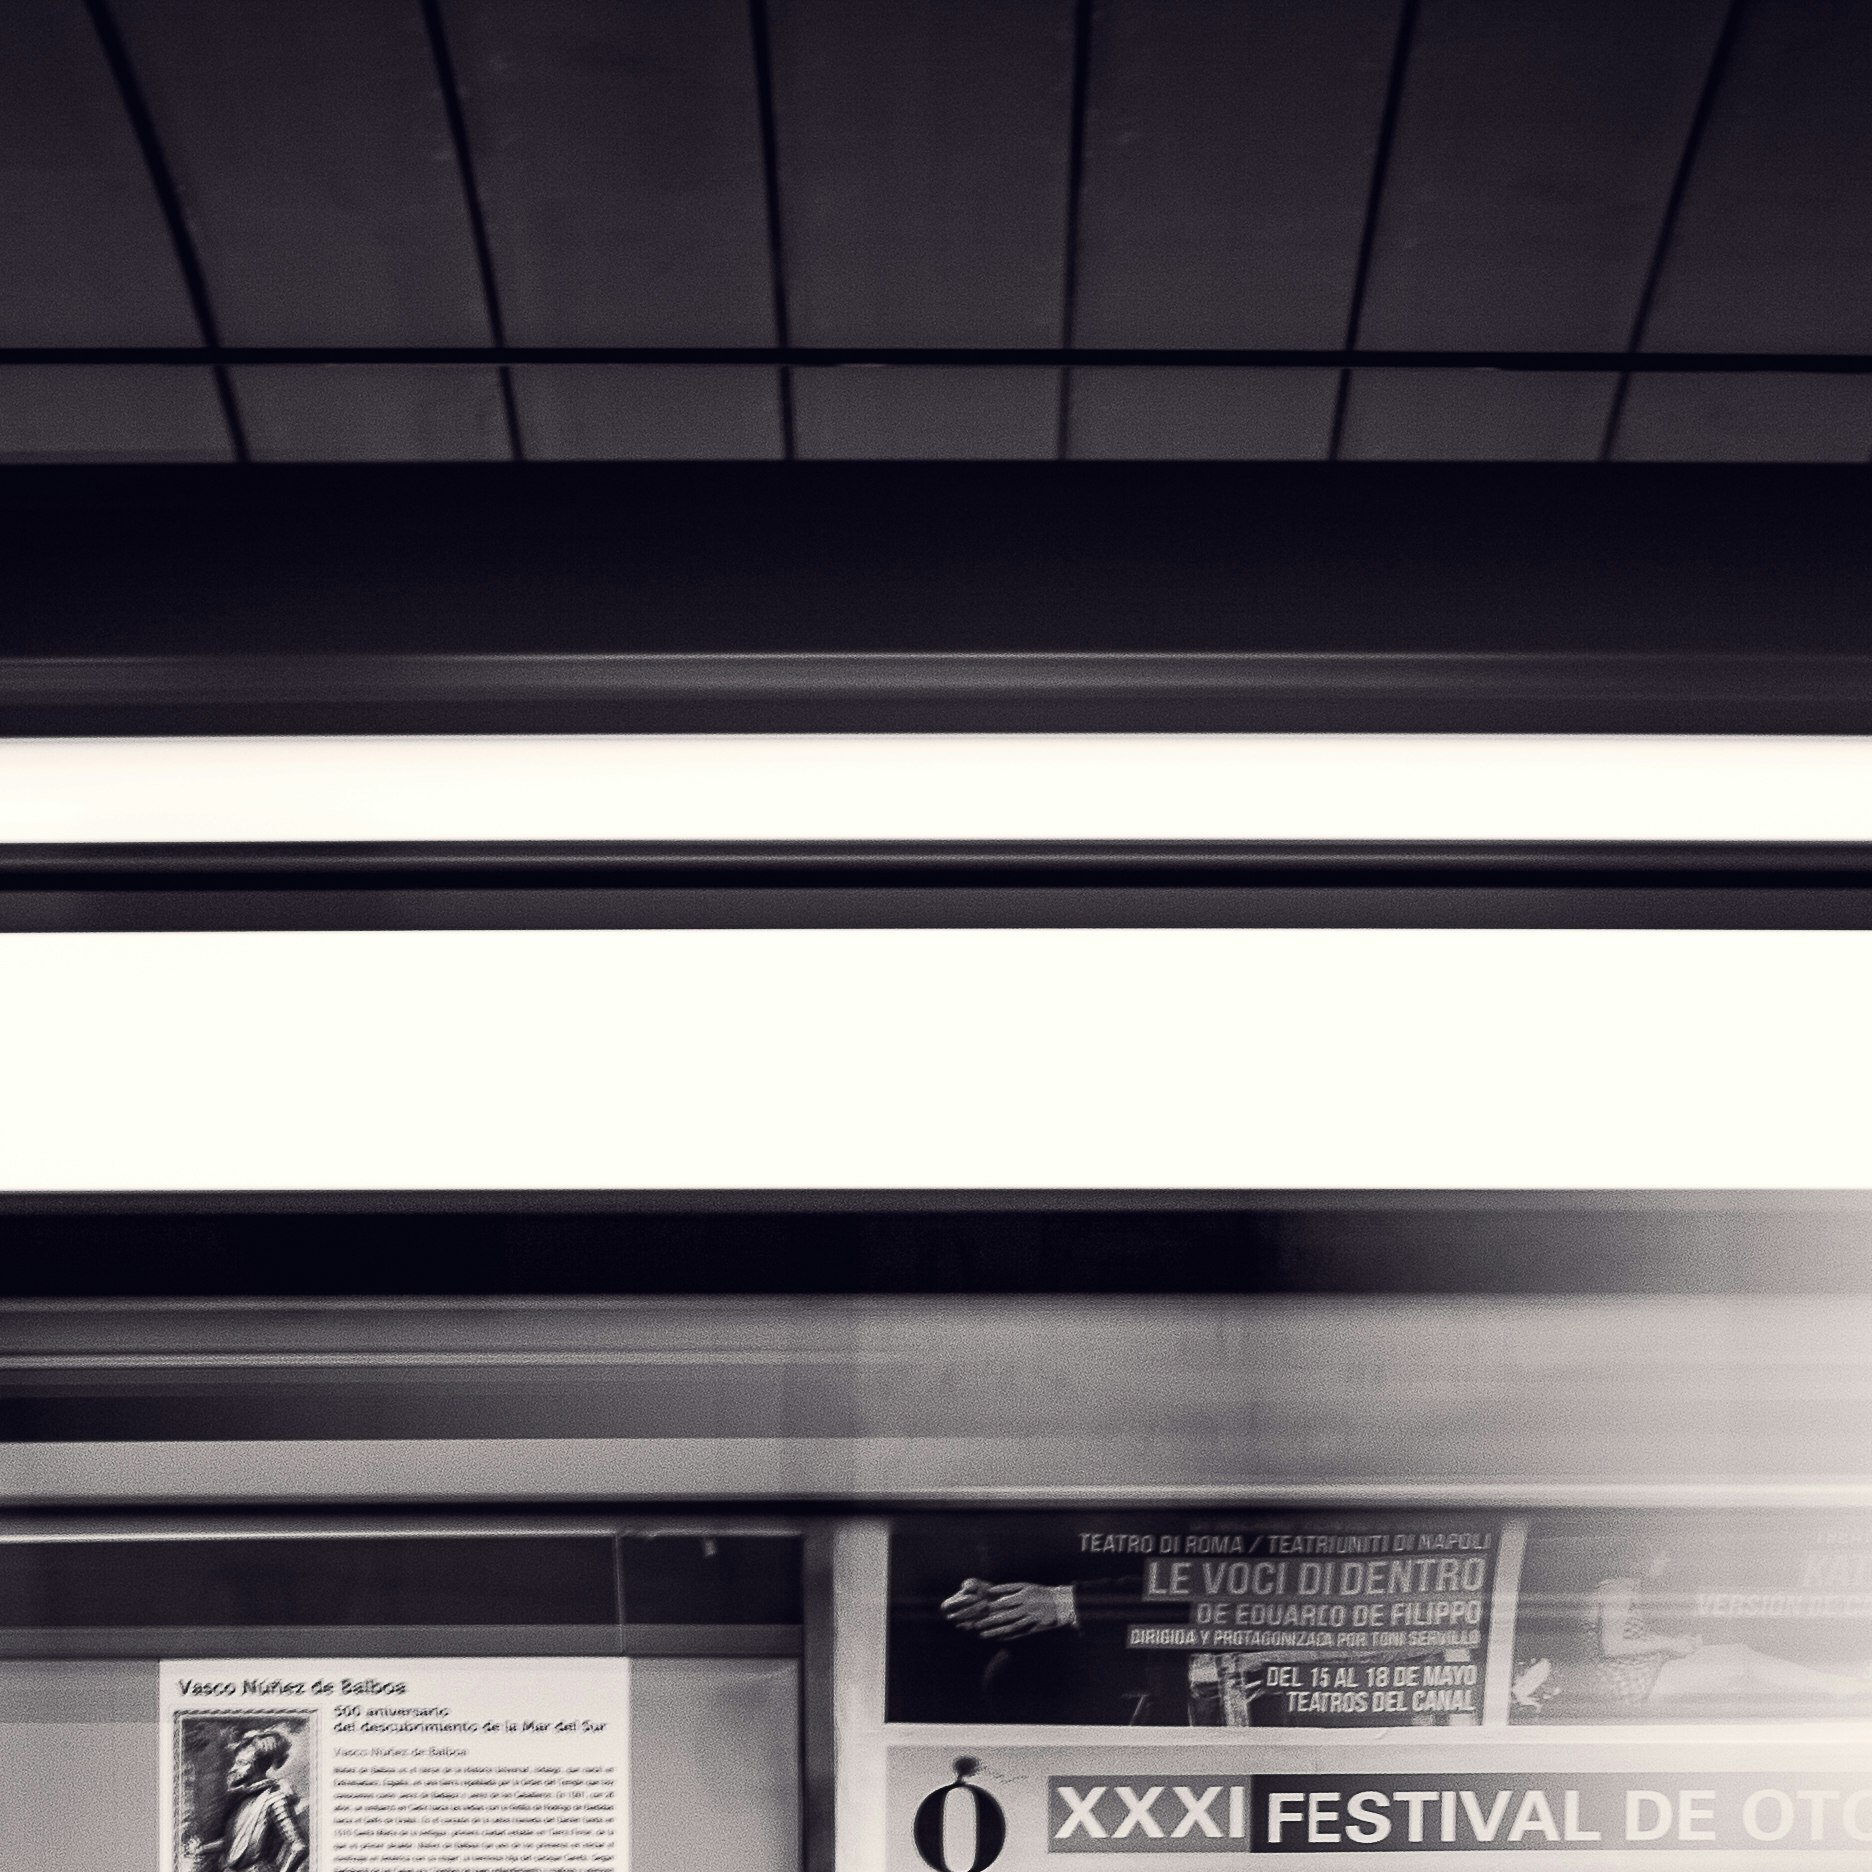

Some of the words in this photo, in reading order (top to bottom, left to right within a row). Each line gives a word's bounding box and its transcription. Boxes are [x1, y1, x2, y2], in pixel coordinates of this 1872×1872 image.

[1079, 1533, 1154, 1554] TEATRO
[1159, 1533, 1179, 1554] DI
[1184, 1533, 1243, 1554] ROMA
[1267, 1533, 1389, 1554] TEATRIUNITI
[1392, 1533, 1415, 1552] DI
[1416, 1531, 1493, 1551] NAPOLI
[1147, 1561, 1192, 1596] LE
[1202, 1561, 1285, 1596] VOCI
[1298, 1560, 1332, 1595] DI
[1340, 1557, 1488, 1595] DENTRO
[1196, 1603, 1229, 1625] DE
[1235, 1603, 1346, 1627] EDUARDO
[1353, 1603, 1384, 1627] DE
[1389, 1600, 1483, 1626] FILIPPO
[1129, 1629, 1197, 1646] DIRIGIDA
[1199, 1629, 1210, 1646] Y
[1214, 1630, 1335, 1647] PROTAGONIZADA
[1336, 1630, 1369, 1647] POR
[1371, 1630, 1406, 1646] TONI
[1407, 1628, 1481, 1646] SERVILLO
[178, 1678, 237, 1696] Vasco
[242, 1678, 306, 1696] Núñez
[310, 1678, 334, 1696] de
[340, 1678, 408, 1696] Balboa
[1266, 1667, 1302, 1687] DEL
[1310, 1667, 1330, 1687] 15
[1333, 1667, 1359, 1687] AL
[1366, 1667, 1390, 1687] 18
[1393, 1667, 1420, 1687] DE
[1422, 1665, 1478, 1686] MAYO
[333, 1705, 361, 1718] 500
[365, 1705, 450, 1718] aniversario
[1285, 1690, 1370, 1713] TEATROS
[1373, 1690, 1409, 1713] DEL
[1411, 1689, 1477, 1711] CANAL
[333, 1720, 355, 1733] del
[360, 1720, 477, 1733] descubrimiento
[482, 1720, 500, 1733] de
[504, 1720, 517, 1733] la
[521, 1720, 550, 1733] Mar
[554, 1720, 577, 1733] del
[581, 1720, 608, 1733] Sur
[333, 1745, 368, 1757] Vasco
[411, 1745, 427, 1757] de
[429, 1745, 467, 1757] Balboa
[1053, 1786, 1246, 1839] XXXI
[1268, 1789, 1601, 1844] FESTIVAL
[1625, 1790, 1717, 1842] DE
